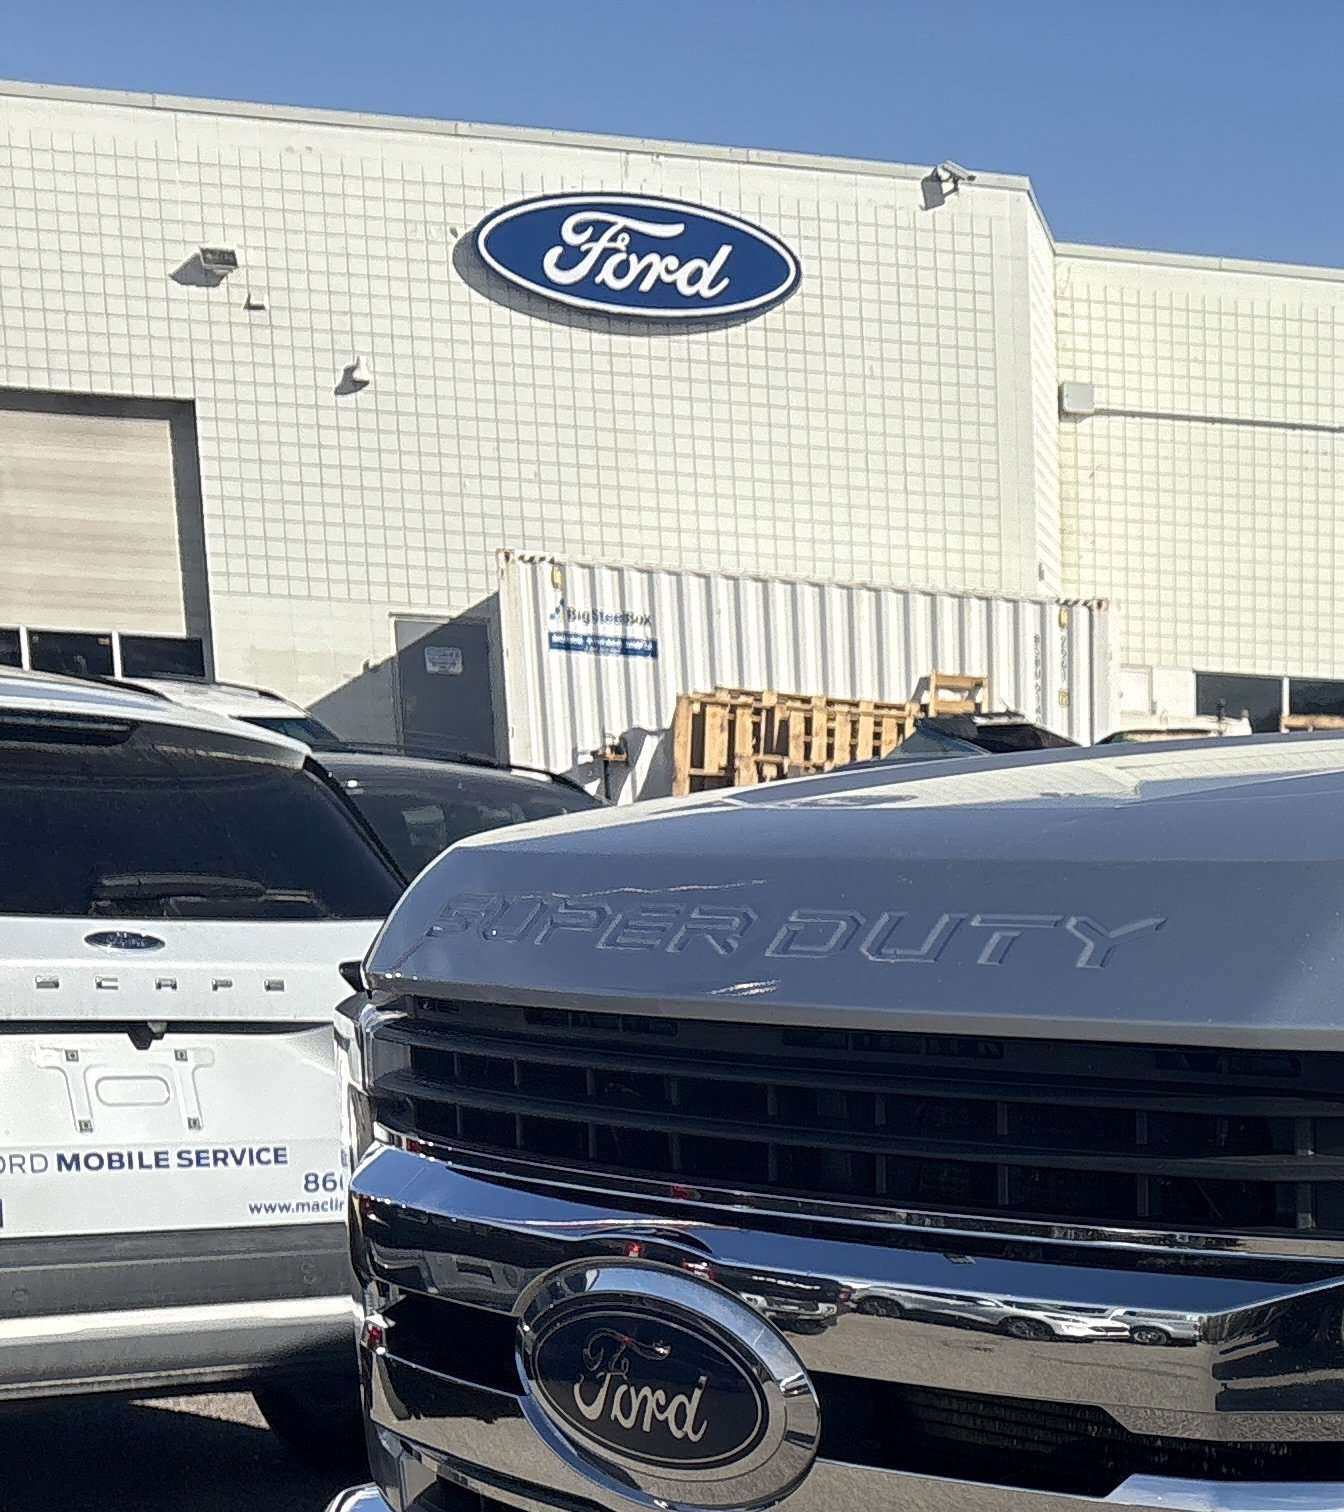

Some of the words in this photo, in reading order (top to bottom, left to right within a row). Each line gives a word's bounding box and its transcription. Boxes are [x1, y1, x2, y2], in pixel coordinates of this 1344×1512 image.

[542, 210, 733, 299] Ford
[424, 891, 759, 955] SUPER
[764, 909, 1169, 969] DUTY
[56, 1151, 171, 1173] MOBILE
[176, 1146, 289, 1169] SERVICE
[303, 1171, 344, 1193] 86
[572, 1327, 709, 1443] Ford
